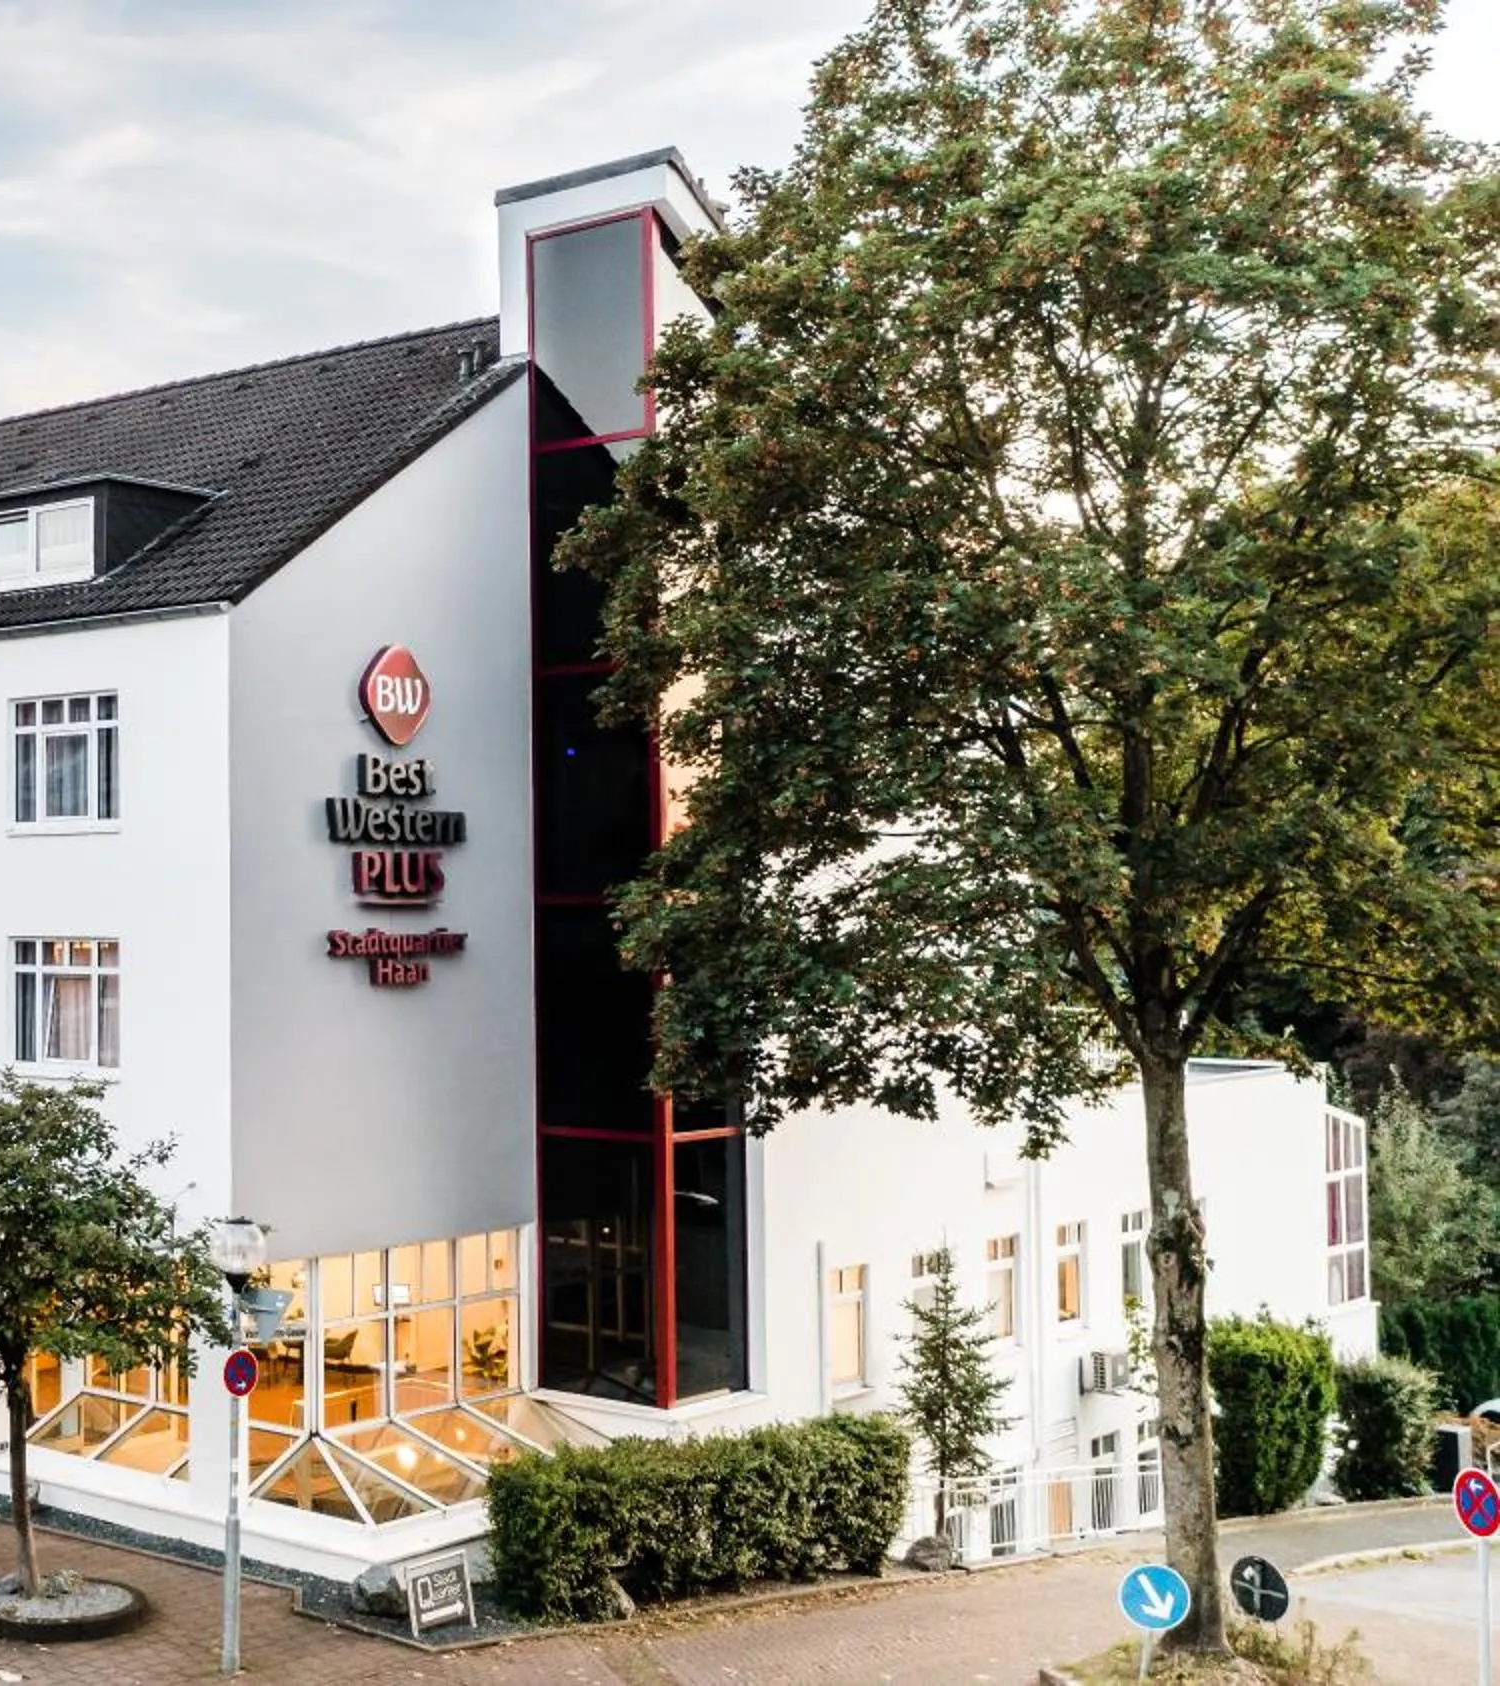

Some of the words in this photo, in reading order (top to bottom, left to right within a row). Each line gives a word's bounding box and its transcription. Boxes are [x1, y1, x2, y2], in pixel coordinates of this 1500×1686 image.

[375, 673, 423, 716] BW
[357, 753, 435, 797] Best
[326, 797, 466, 843] Western
[352, 850, 445, 897] PLUS
[327, 928, 467, 957] Stadtquartier
[370, 959, 431, 985] Haar
